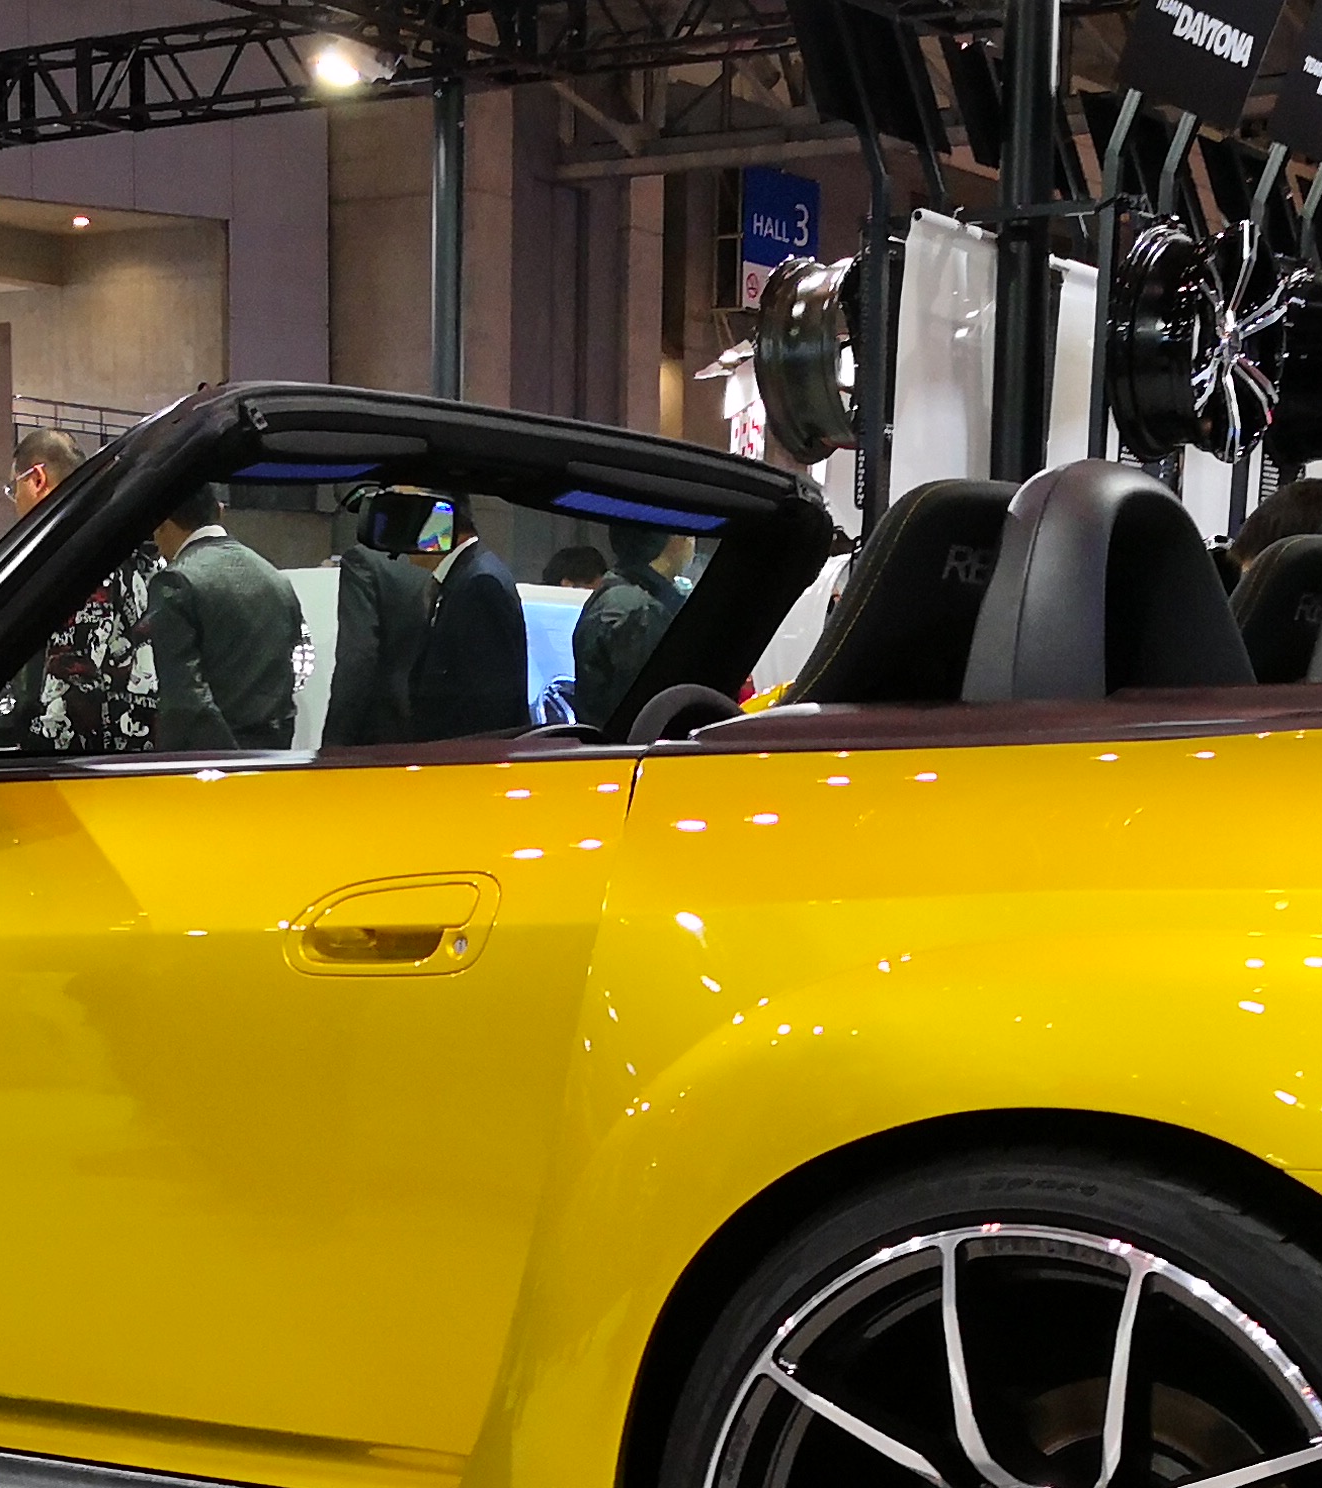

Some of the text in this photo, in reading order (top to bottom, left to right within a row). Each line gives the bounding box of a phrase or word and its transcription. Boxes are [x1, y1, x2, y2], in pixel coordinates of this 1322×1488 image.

[1173, 5, 1254, 67] DAYTONA
[753, 203, 809, 247] HALL 3
